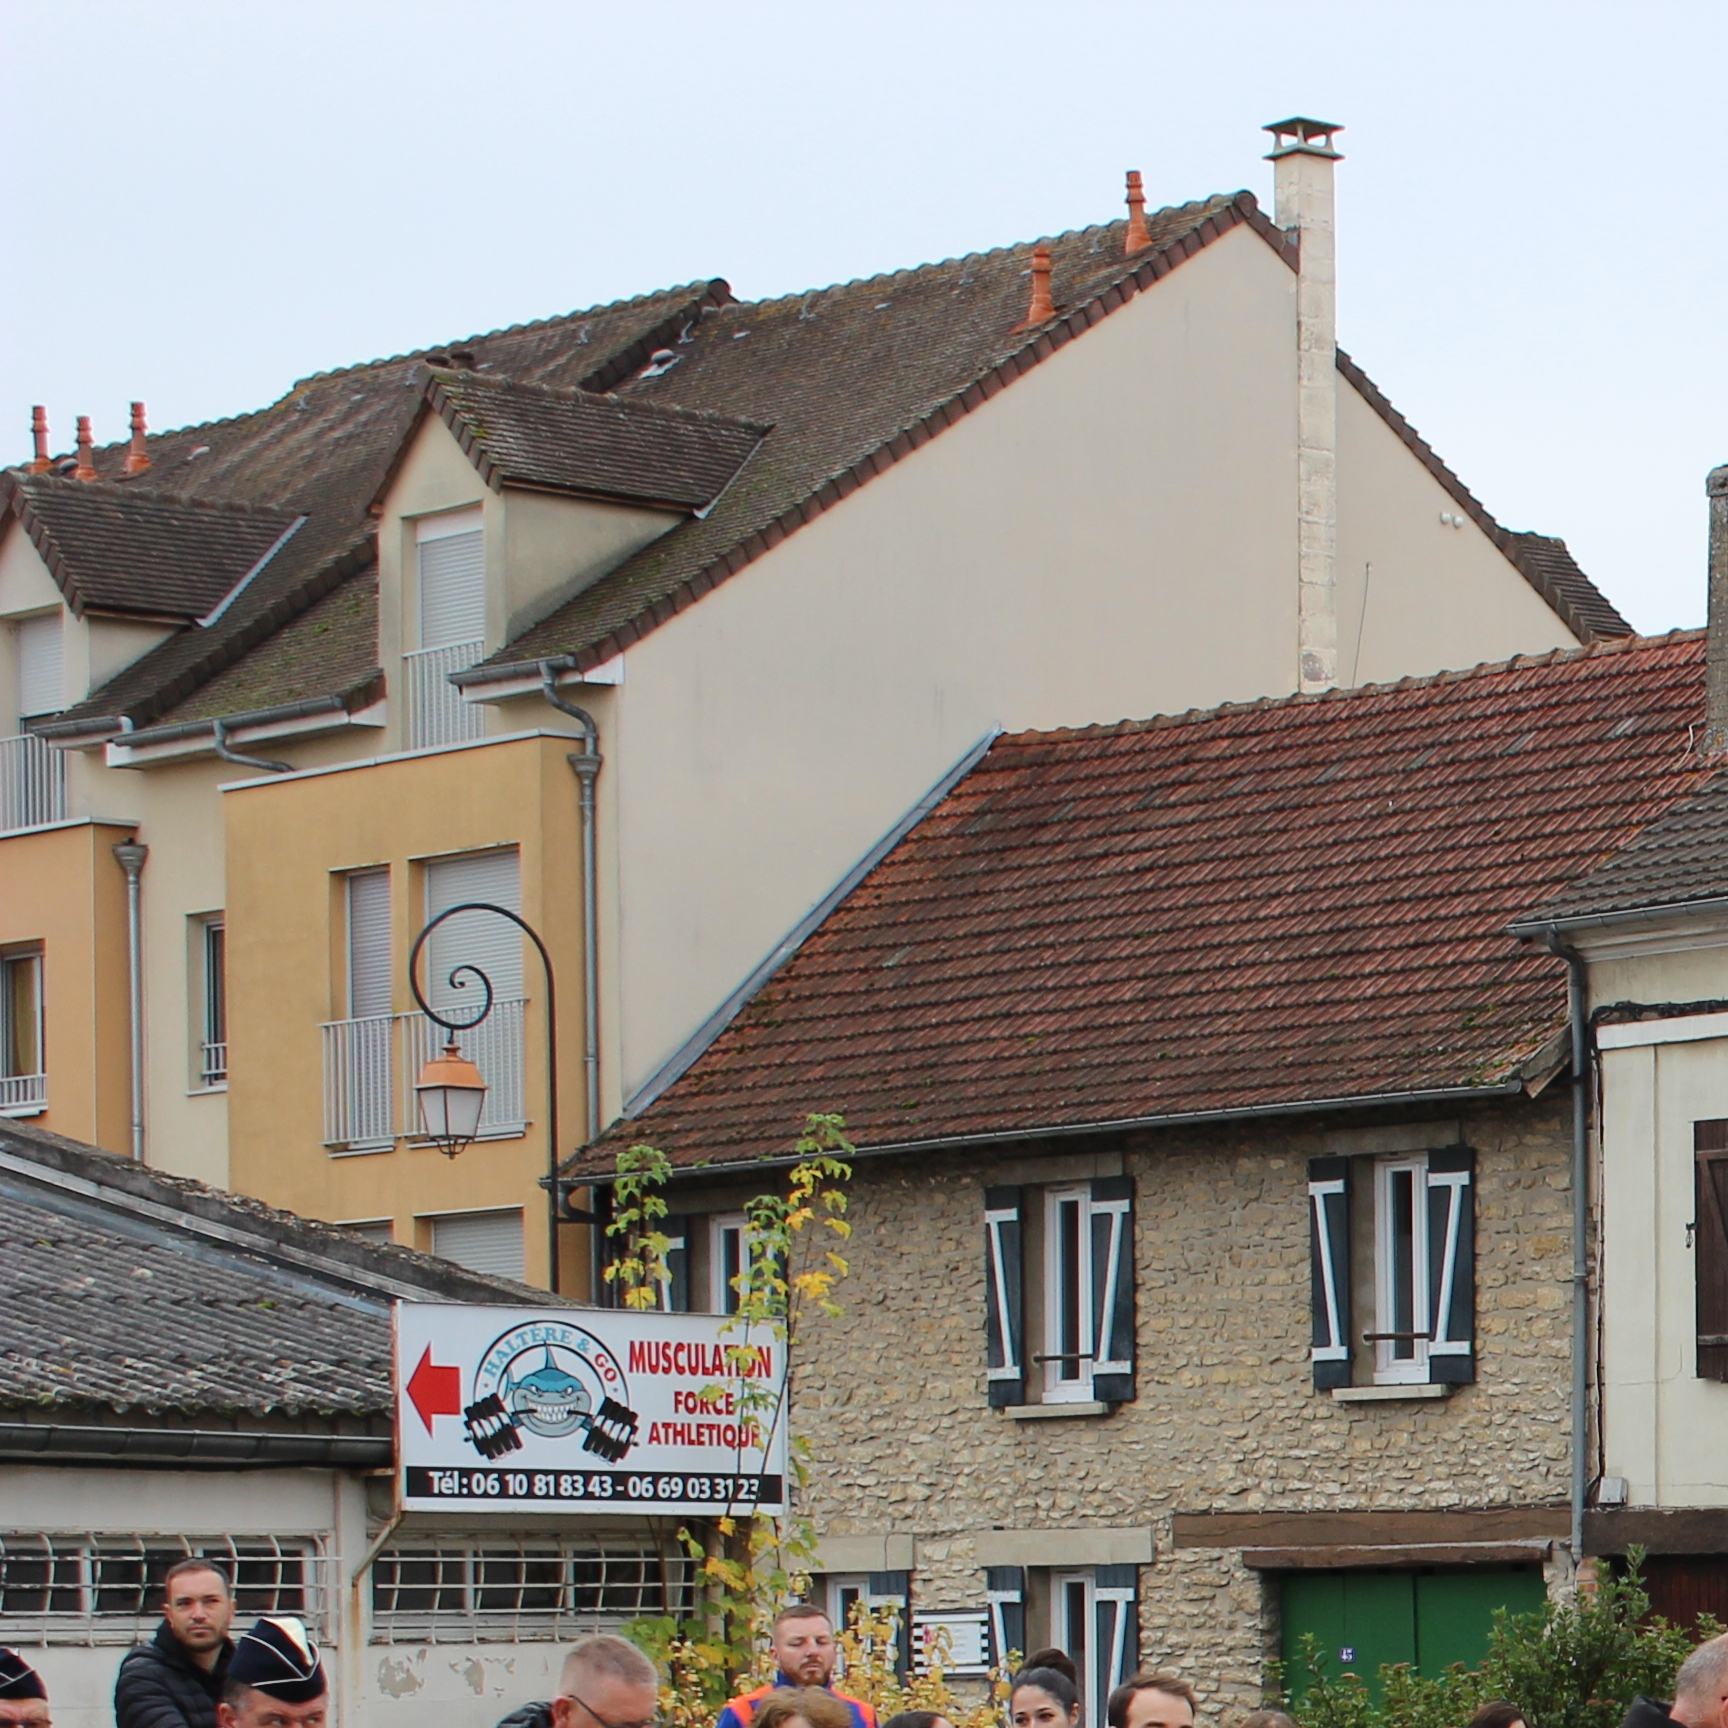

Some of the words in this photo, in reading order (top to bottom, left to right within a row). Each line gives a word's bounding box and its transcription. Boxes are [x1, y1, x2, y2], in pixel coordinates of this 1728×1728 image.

[577, 1338, 592, 1354] &
[595, 1353, 617, 1382] GO
[629, 1340, 772, 1378] MUSCULATION
[674, 1391, 735, 1415] FORCE
[648, 1422, 761, 1451] ATHLETIQUE
[471, 1473, 500, 1495] 06
[504, 1474, 528, 1495] 10
[533, 1475, 555, 1496] 81
[559, 1475, 584, 1497] 83
[587, 1476, 613, 1497] 43
[628, 1476, 654, 1498] 06
[657, 1477, 683, 1498] 69
[687, 1477, 711, 1499] 03
[714, 1478, 734, 1499] 31
[737, 1478, 760, 1500] 23
